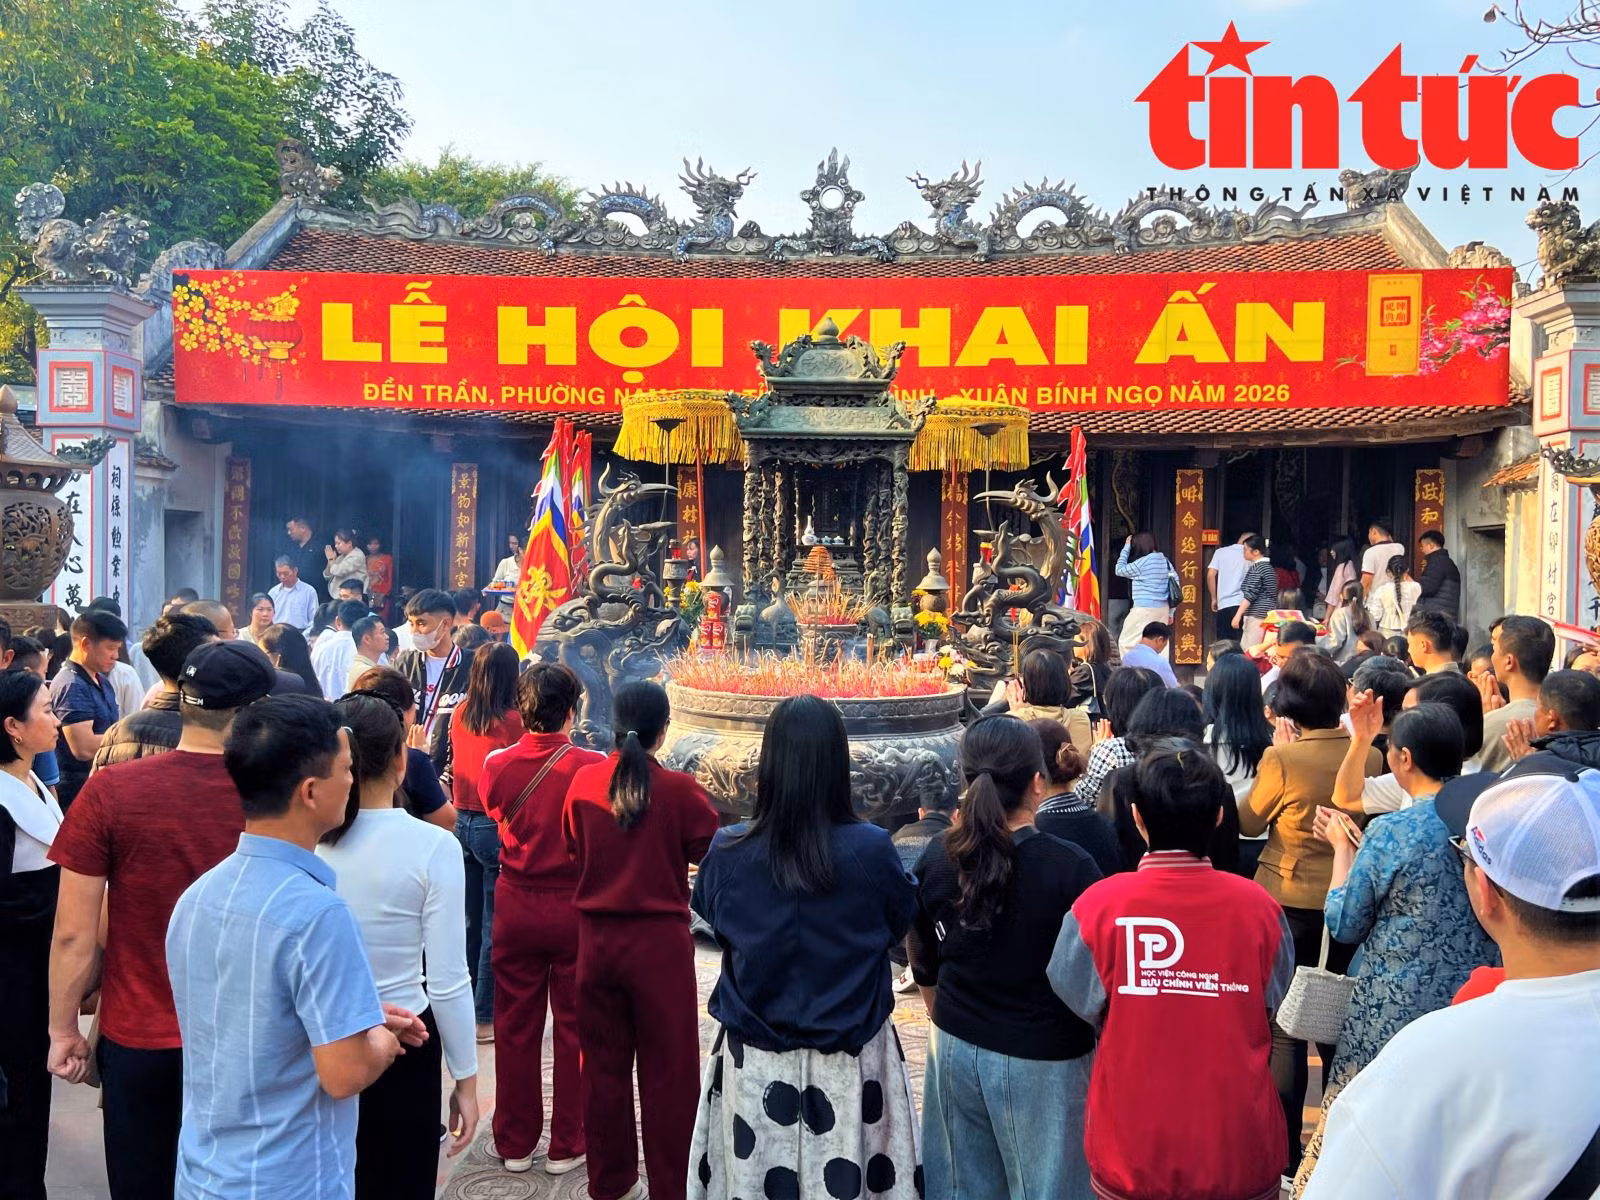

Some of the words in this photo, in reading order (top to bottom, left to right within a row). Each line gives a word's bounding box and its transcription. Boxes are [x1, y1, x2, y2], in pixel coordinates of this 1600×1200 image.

[321, 281, 448, 364] LỄ
[497, 294, 724, 384] HỘI
[778, 305, 1089, 367] KHAI
[1134, 282, 1326, 364] ẤN
[363, 377, 413, 402] ĐỀN
[421, 378, 495, 406] TRẦN,
[501, 382, 605, 406] PHƯỜNG
[960, 383, 1028, 406] XUÂN
[1037, 382, 1097, 405] BÍNH
[1106, 384, 1163, 408] NGỌ
[1170, 380, 1225, 403] NĂM
[1234, 384, 1291, 403] 2026
[1140, 978, 1161, 987] BƯU
[1162, 978, 1194, 989] CHÍNH
[1141, 970, 1157, 978] HỌC
[1158, 969, 1175, 978] VIỆN
[1176, 970, 1198, 979] CÔNG
[1198, 973, 1219, 982] NGHỆ
